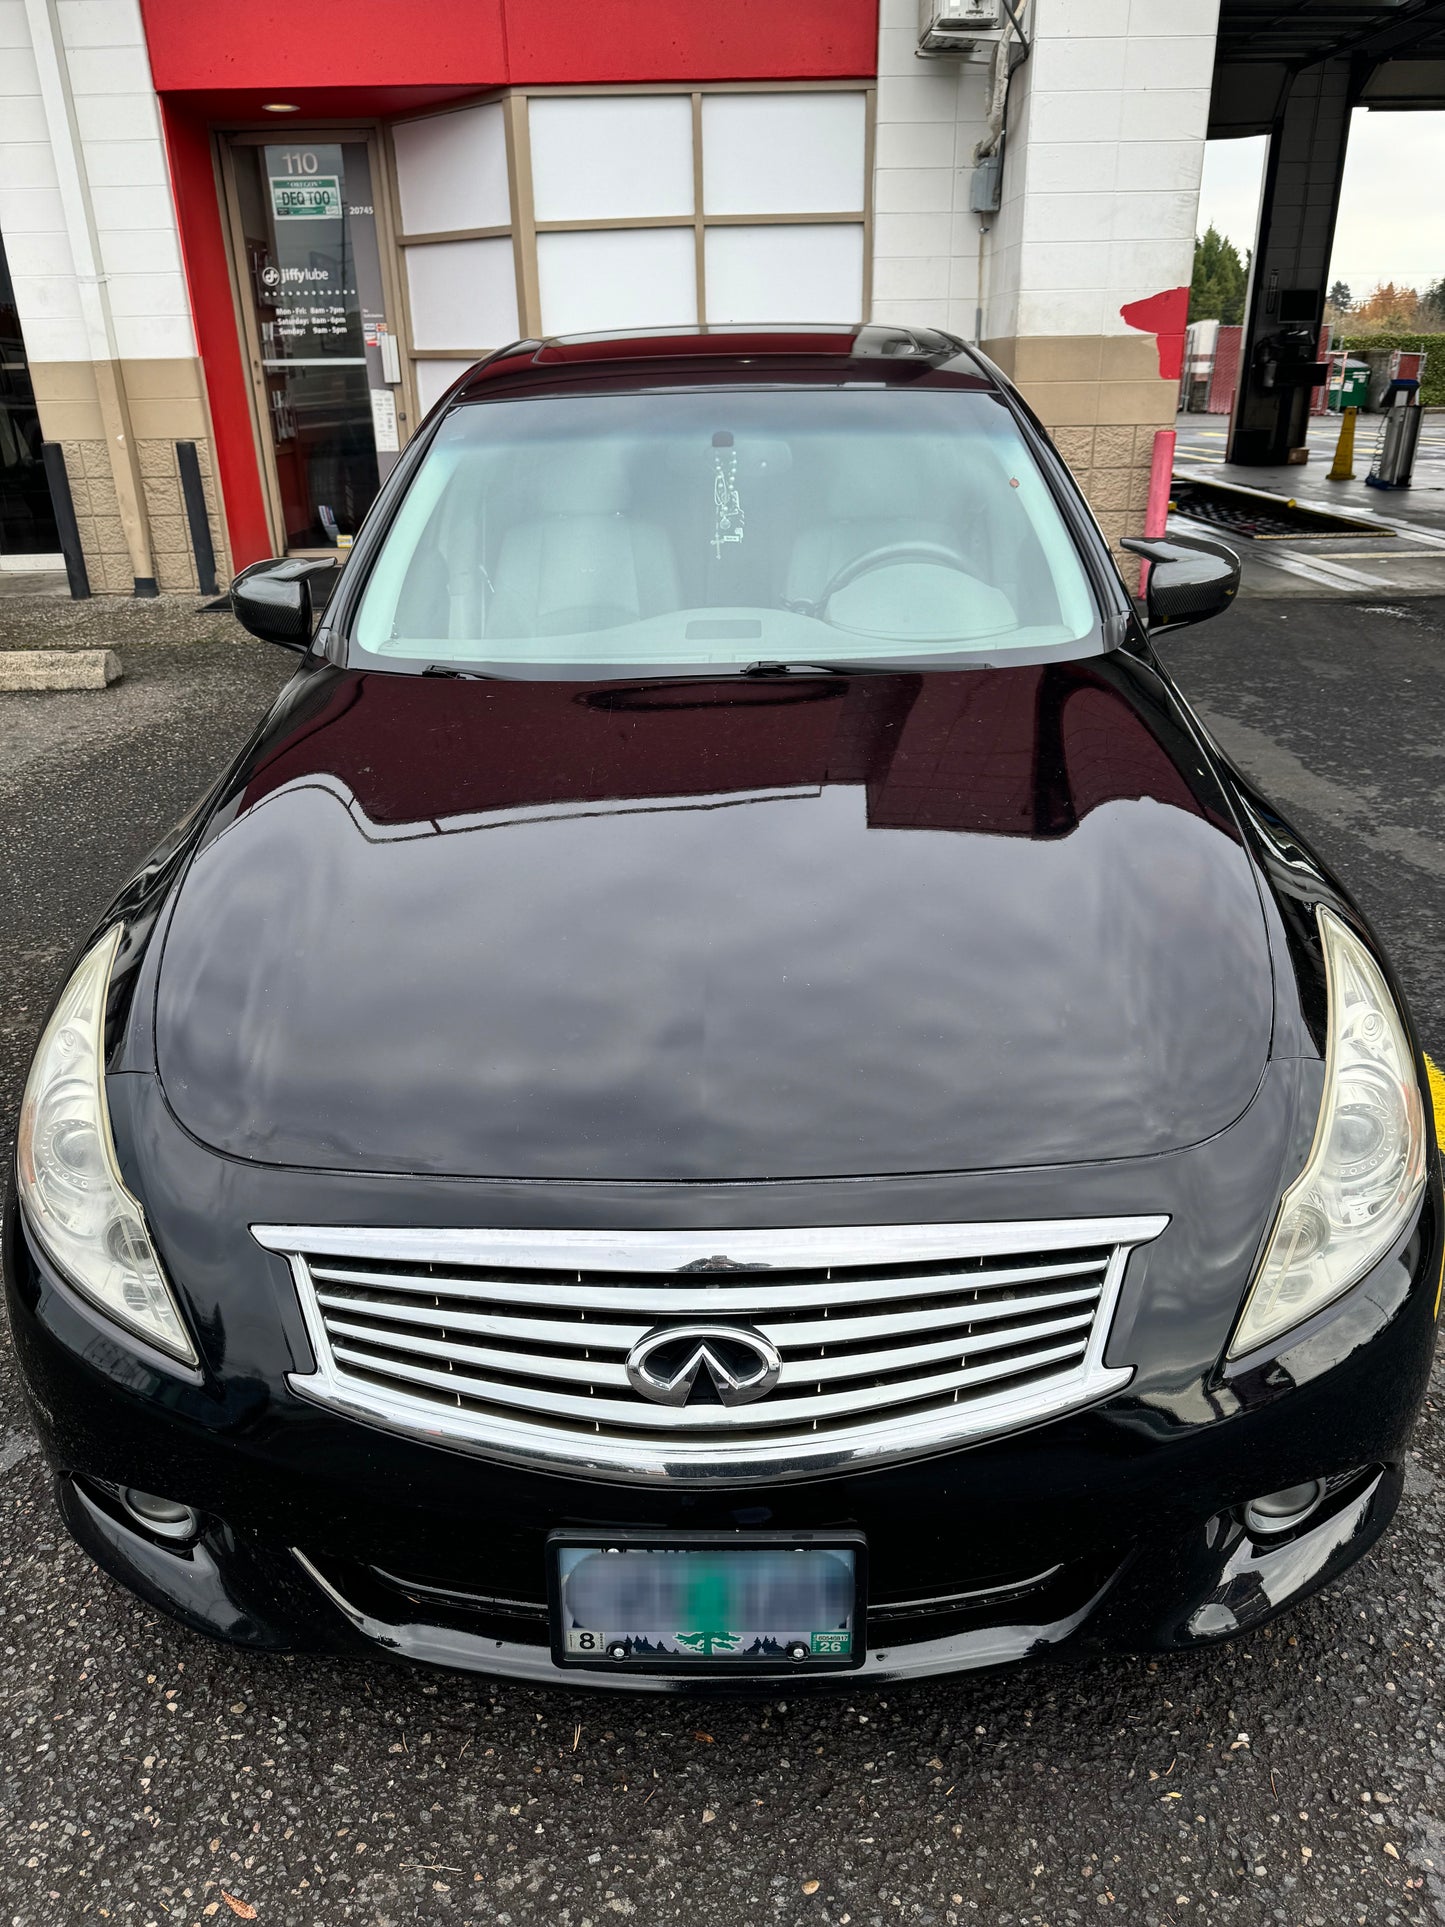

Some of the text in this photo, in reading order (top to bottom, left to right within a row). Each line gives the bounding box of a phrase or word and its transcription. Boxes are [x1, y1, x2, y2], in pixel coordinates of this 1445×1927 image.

[282, 152, 318, 174] 110
[282, 190, 331, 206] DEQ TOO
[349, 206, 374, 215] 20745
[277, 317, 309, 326] Saturday:
[279, 327, 306, 336] Sunday:
[579, 1632, 596, 1650] 8
[819, 1641, 842, 1652] 26
